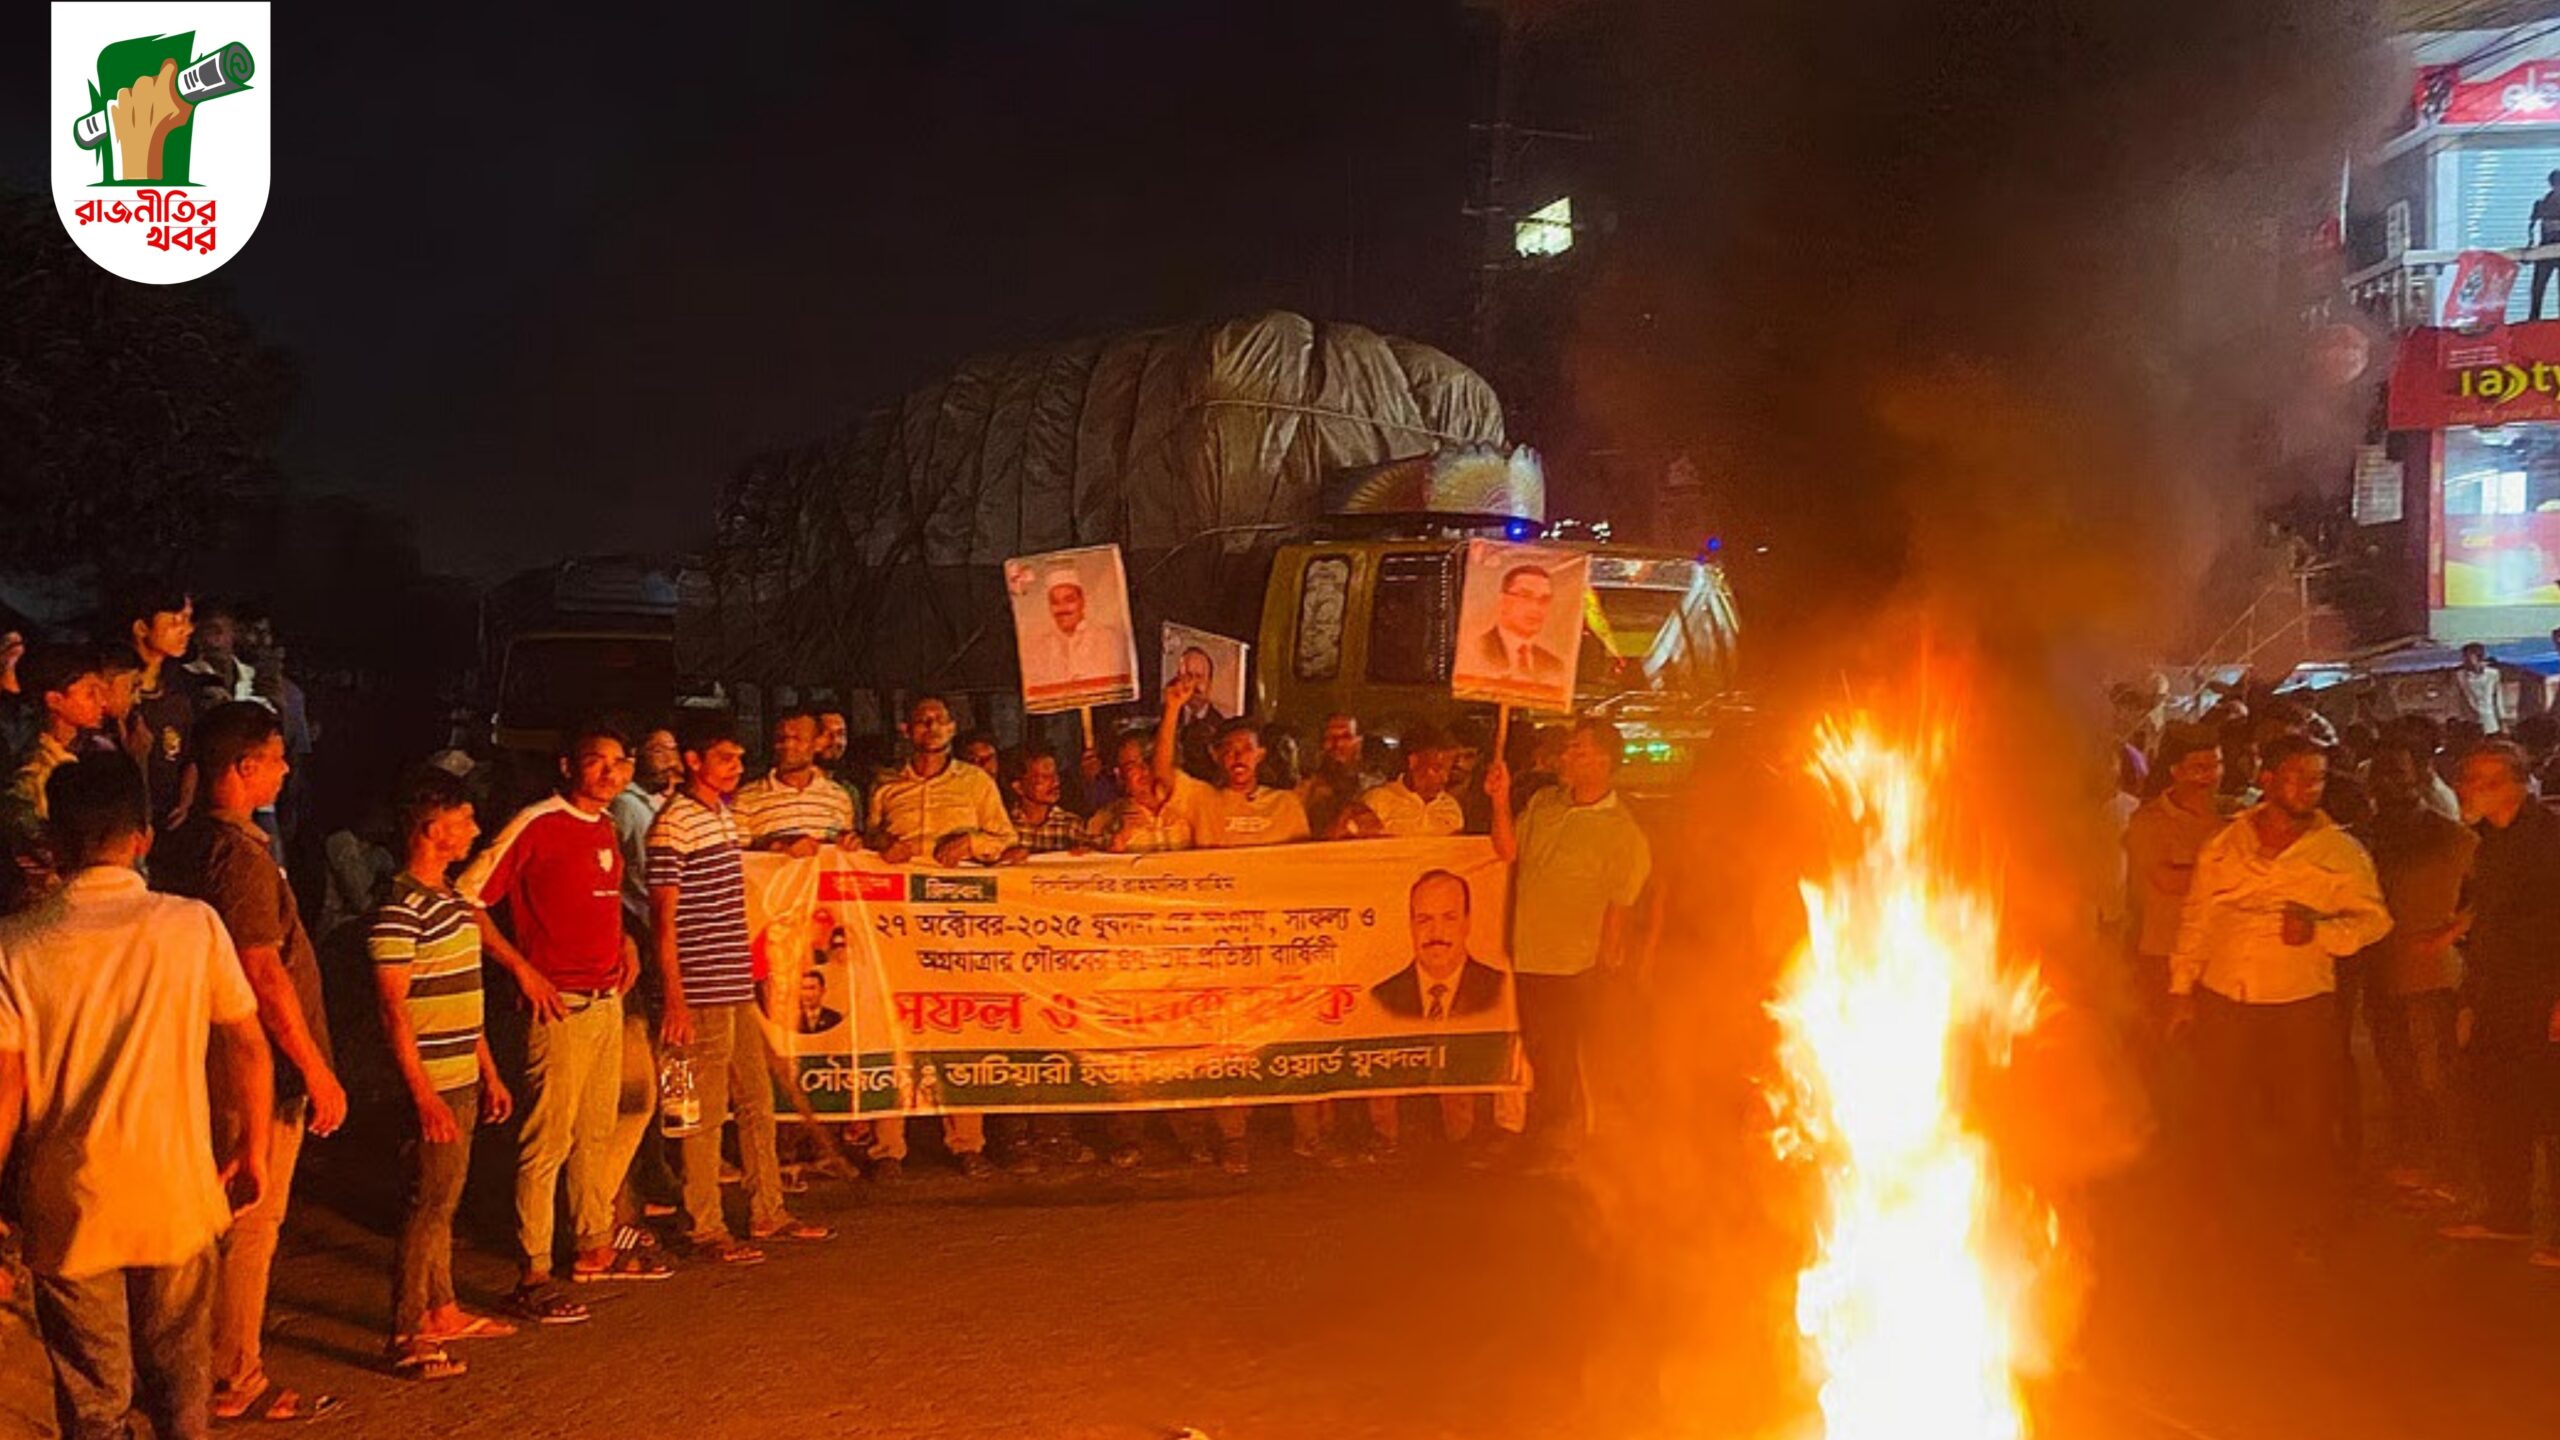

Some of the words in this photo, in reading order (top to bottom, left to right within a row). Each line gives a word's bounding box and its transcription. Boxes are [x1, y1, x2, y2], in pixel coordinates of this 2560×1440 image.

[876, 913, 907, 938] ২৭
[1360, 907, 1376, 927] ও
[894, 990, 1030, 1033] সফল
[945, 1054, 1072, 1087] ভাটিয়ারী
[1269, 1047, 1343, 1078] ওয়ার্ড
